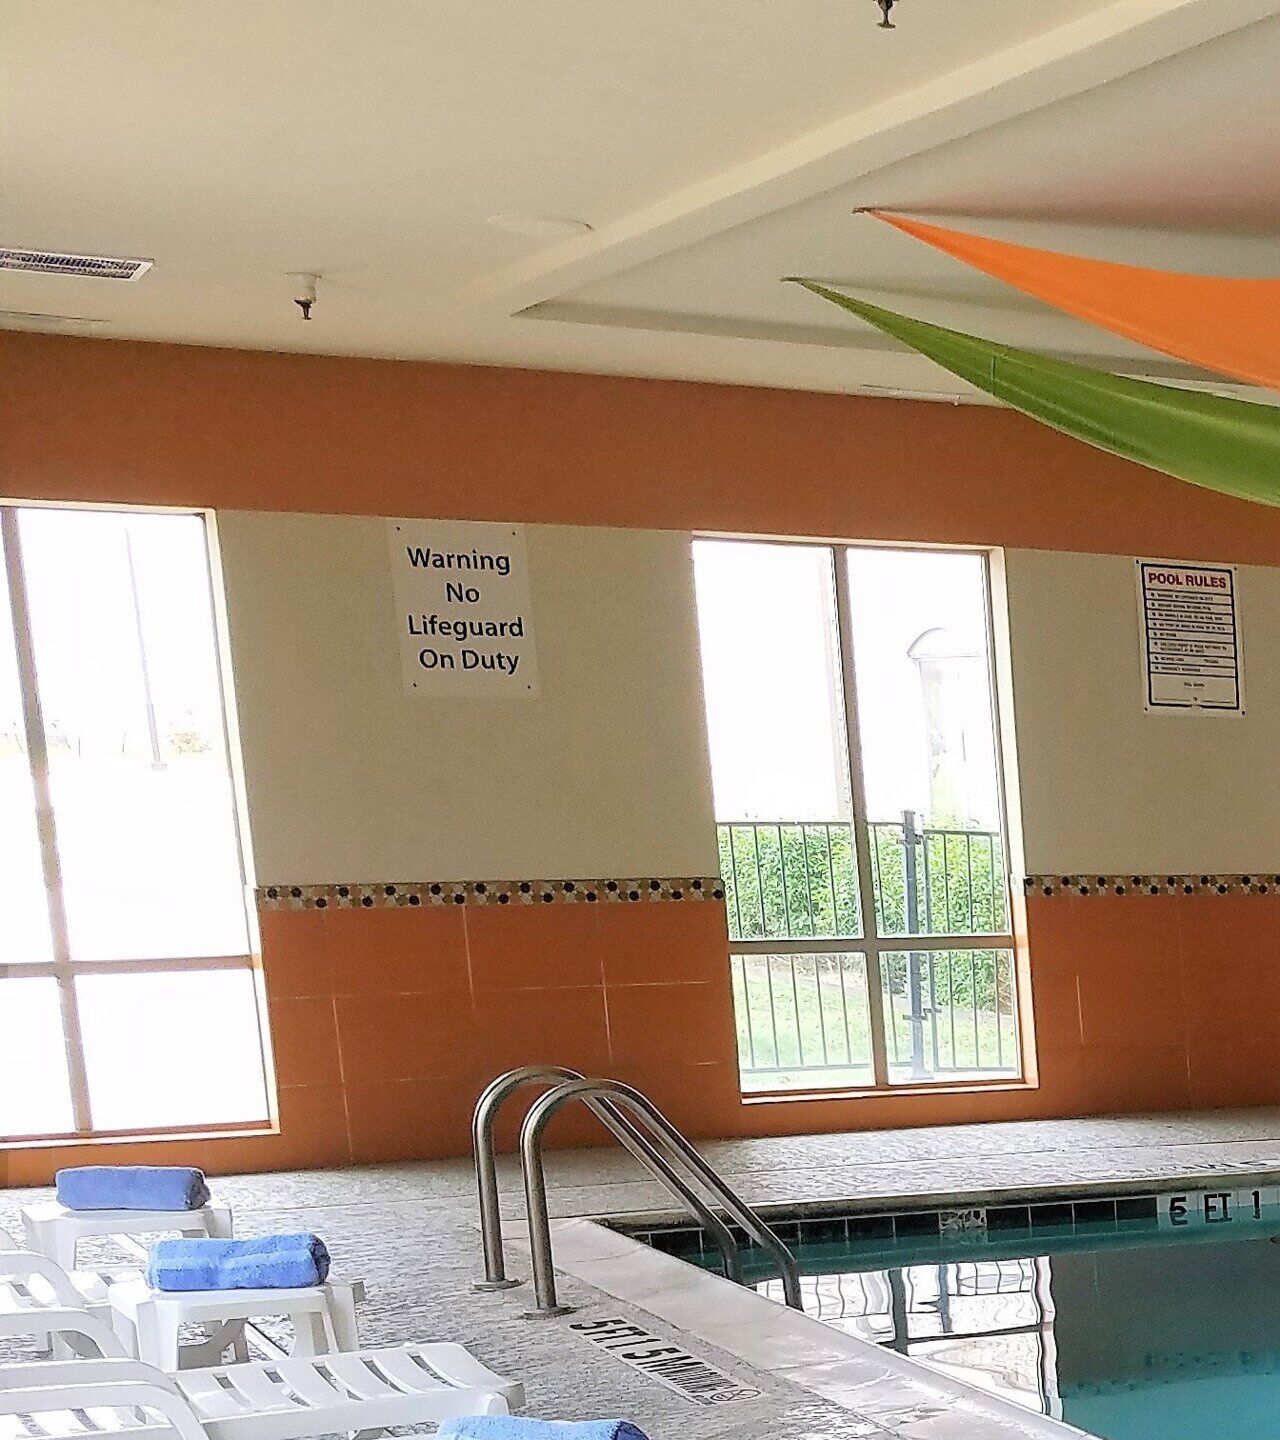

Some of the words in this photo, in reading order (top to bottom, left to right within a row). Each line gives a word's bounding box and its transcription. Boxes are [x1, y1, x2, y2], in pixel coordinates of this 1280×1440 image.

[407, 546, 510, 575] Warning
[446, 582, 480, 602] No
[1149, 573, 1183, 586] POOL
[1186, 575, 1227, 589] RULES
[408, 614, 524, 641] Lifeguard
[419, 649, 455, 669] On
[461, 650, 519, 675] Duty
